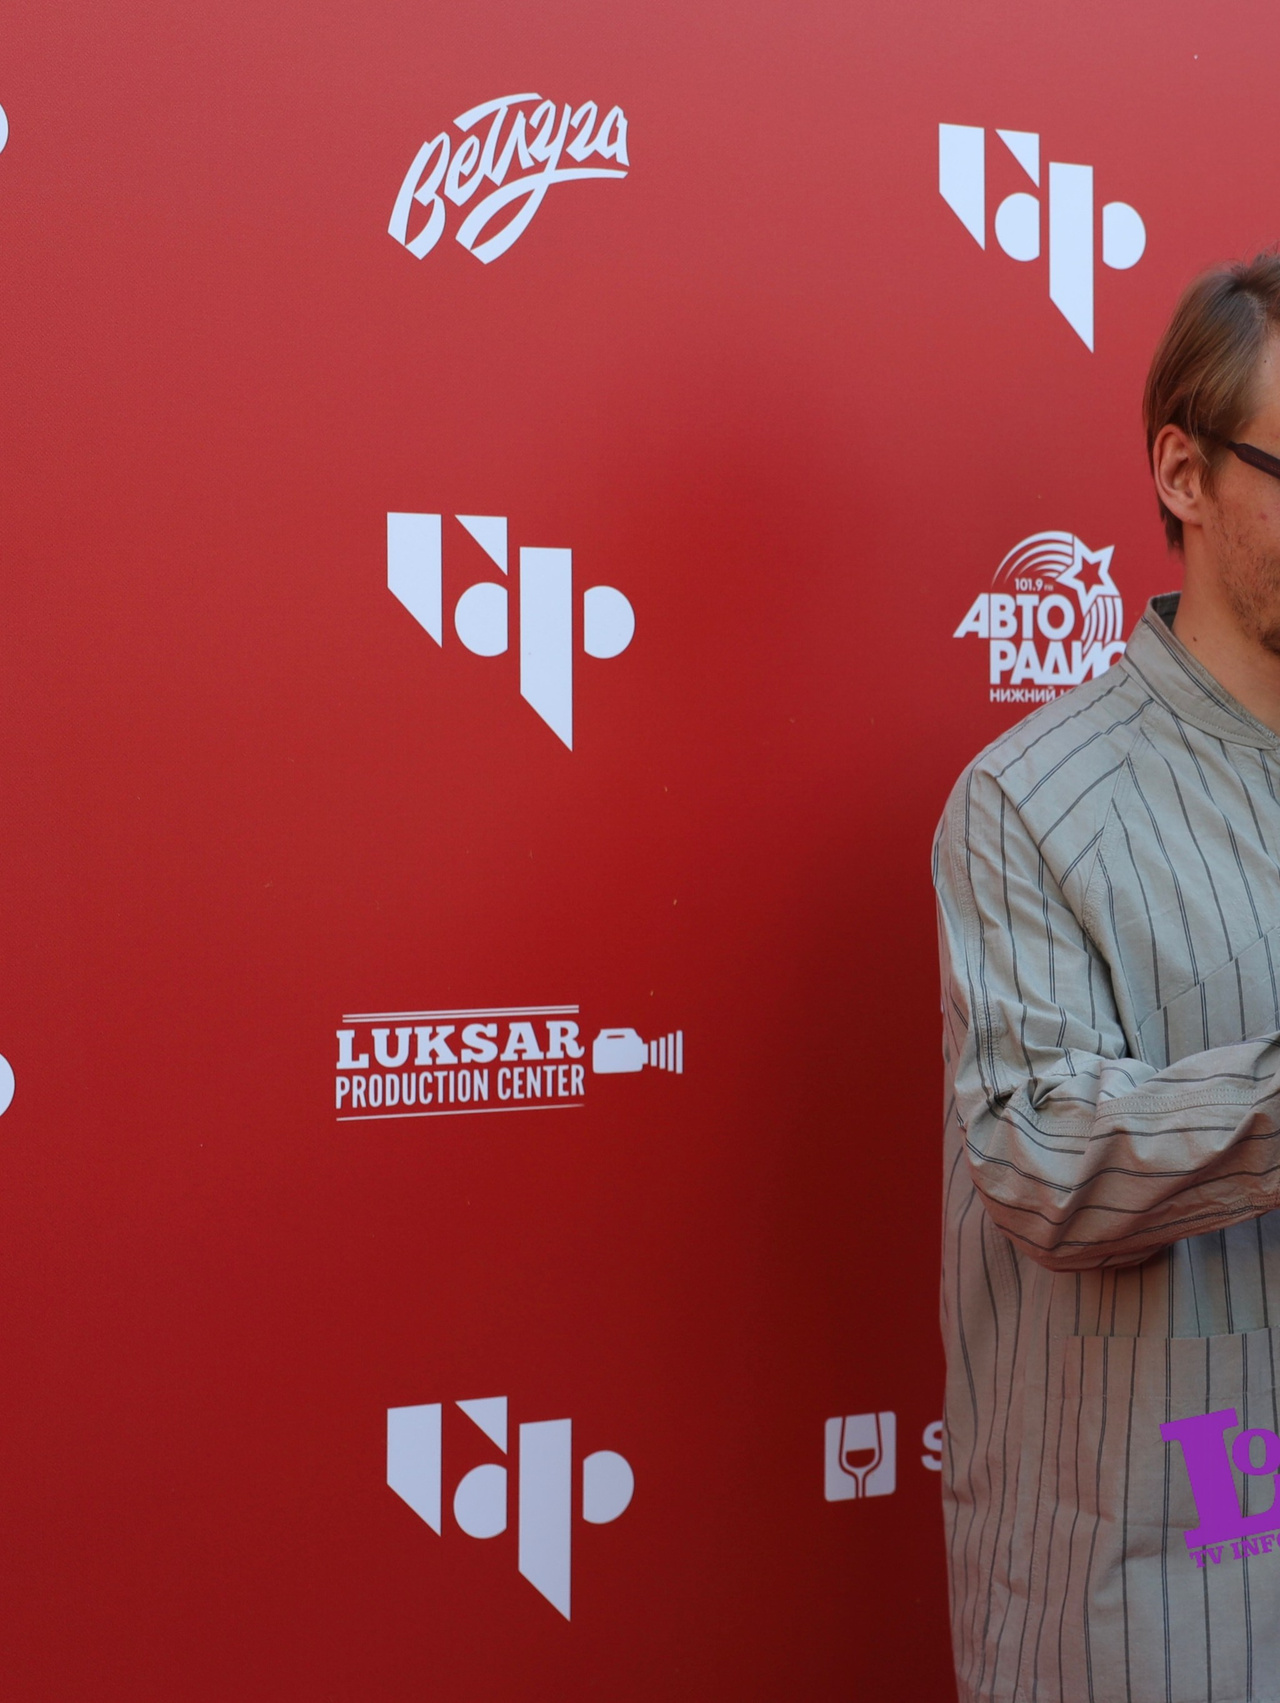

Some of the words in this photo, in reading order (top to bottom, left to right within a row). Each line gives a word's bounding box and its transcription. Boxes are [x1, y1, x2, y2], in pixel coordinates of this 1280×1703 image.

[1014, 577, 1043, 591] 101.9
[953, 593, 1075, 640] АВТО
[990, 686, 1056, 703] НИЖНИЙ
[336, 1020, 585, 1069] LUKSAR
[336, 1069, 489, 1109] PRODUCTION
[497, 1064, 585, 1100] CENTER
